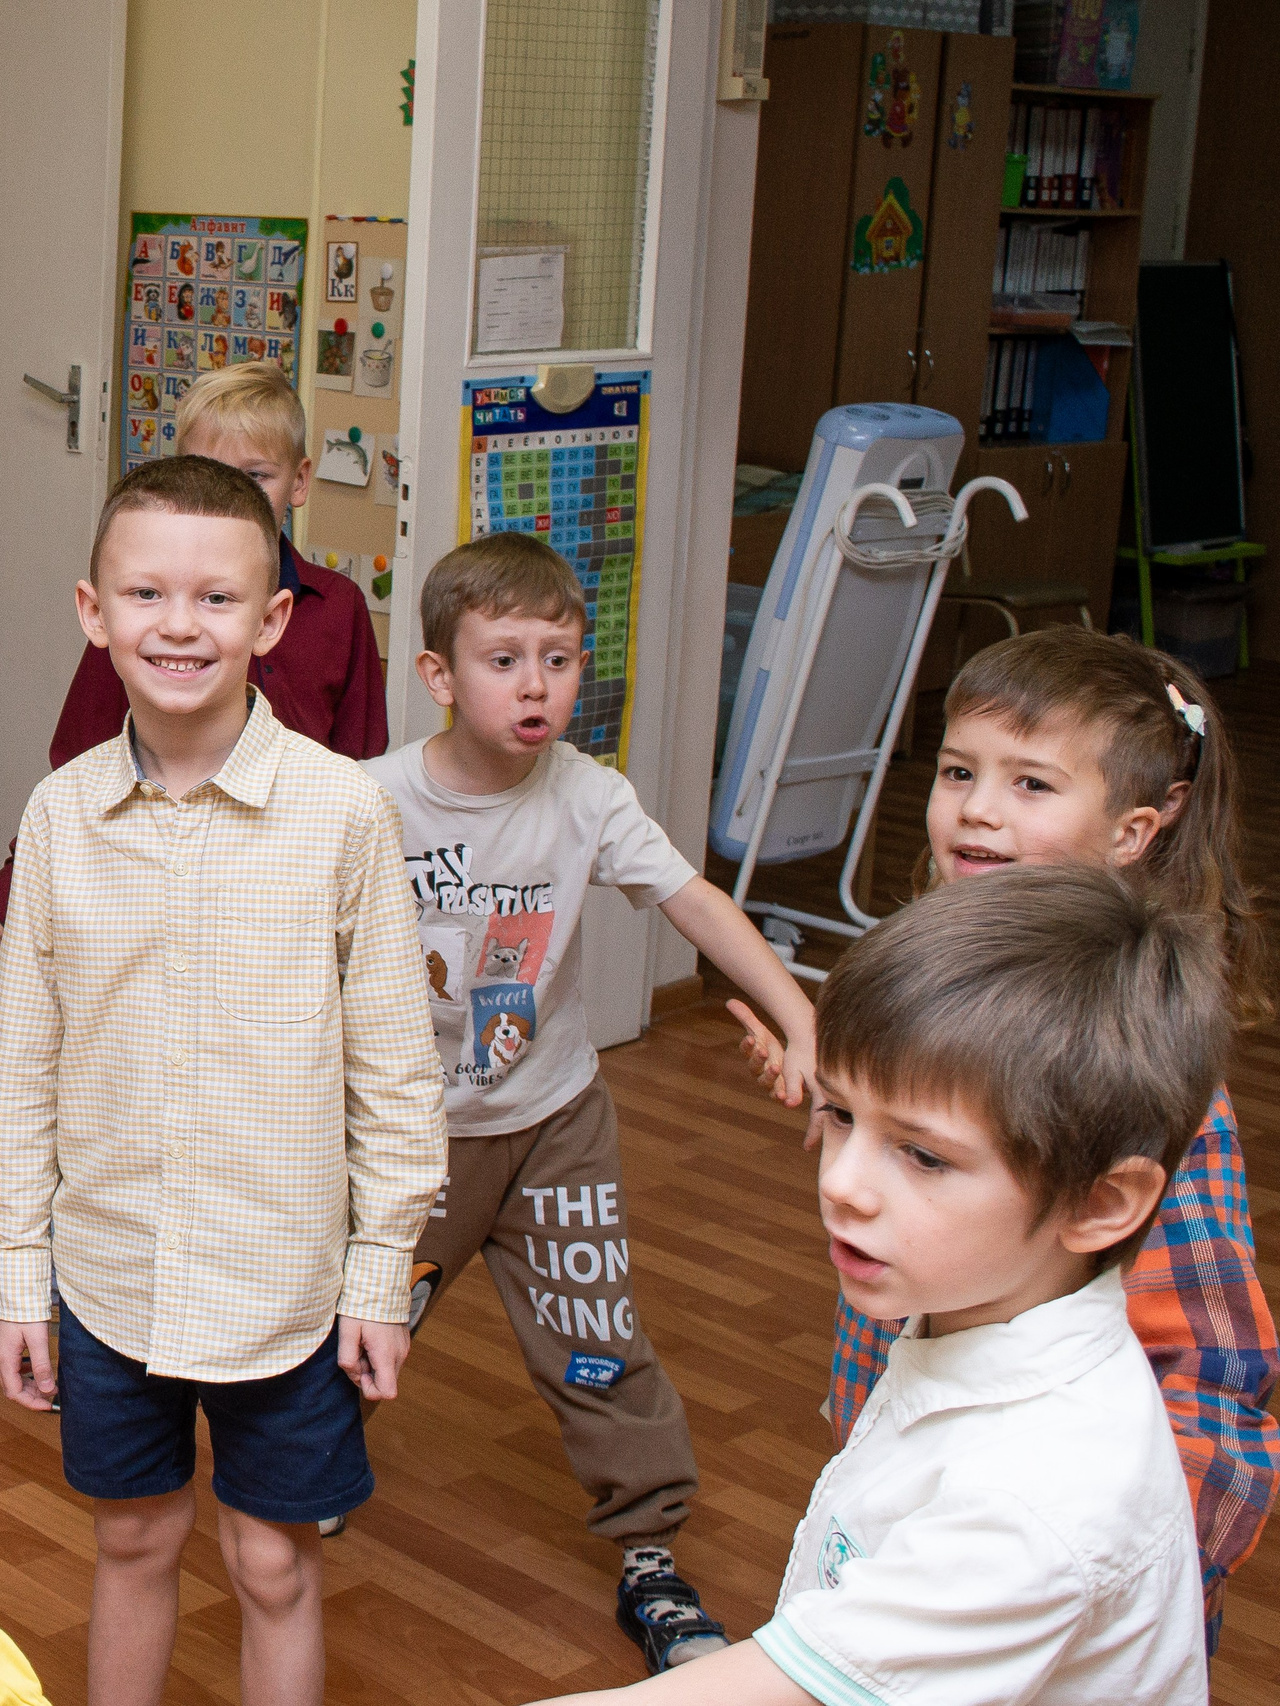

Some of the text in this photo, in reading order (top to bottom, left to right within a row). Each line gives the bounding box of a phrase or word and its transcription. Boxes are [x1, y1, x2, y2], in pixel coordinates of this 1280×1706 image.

[189, 218, 246, 235] Алфавит
[138, 240, 284, 266] А Б В Г Д
[133, 283, 145, 302] Е
[200, 287, 217, 306] Ж
[234, 289, 246, 308] З
[269, 292, 283, 311] И
[330, 279, 355, 297] Кк
[133, 323, 281, 358] Й К Л М Н
[130, 373, 179, 396] О П
[130, 418, 176, 441] У Ф
[492, 439, 499, 449] А
[507, 438, 514, 448] Е
[555, 434, 562, 444] О
[571, 433, 577, 443] У
[436, 882, 554, 917] POSITIVE
[522, 1182, 619, 1227] THE
[524, 1234, 629, 1284] LION
[528, 1286, 633, 1342] KING
[575, 1356, 588, 1364] NO
